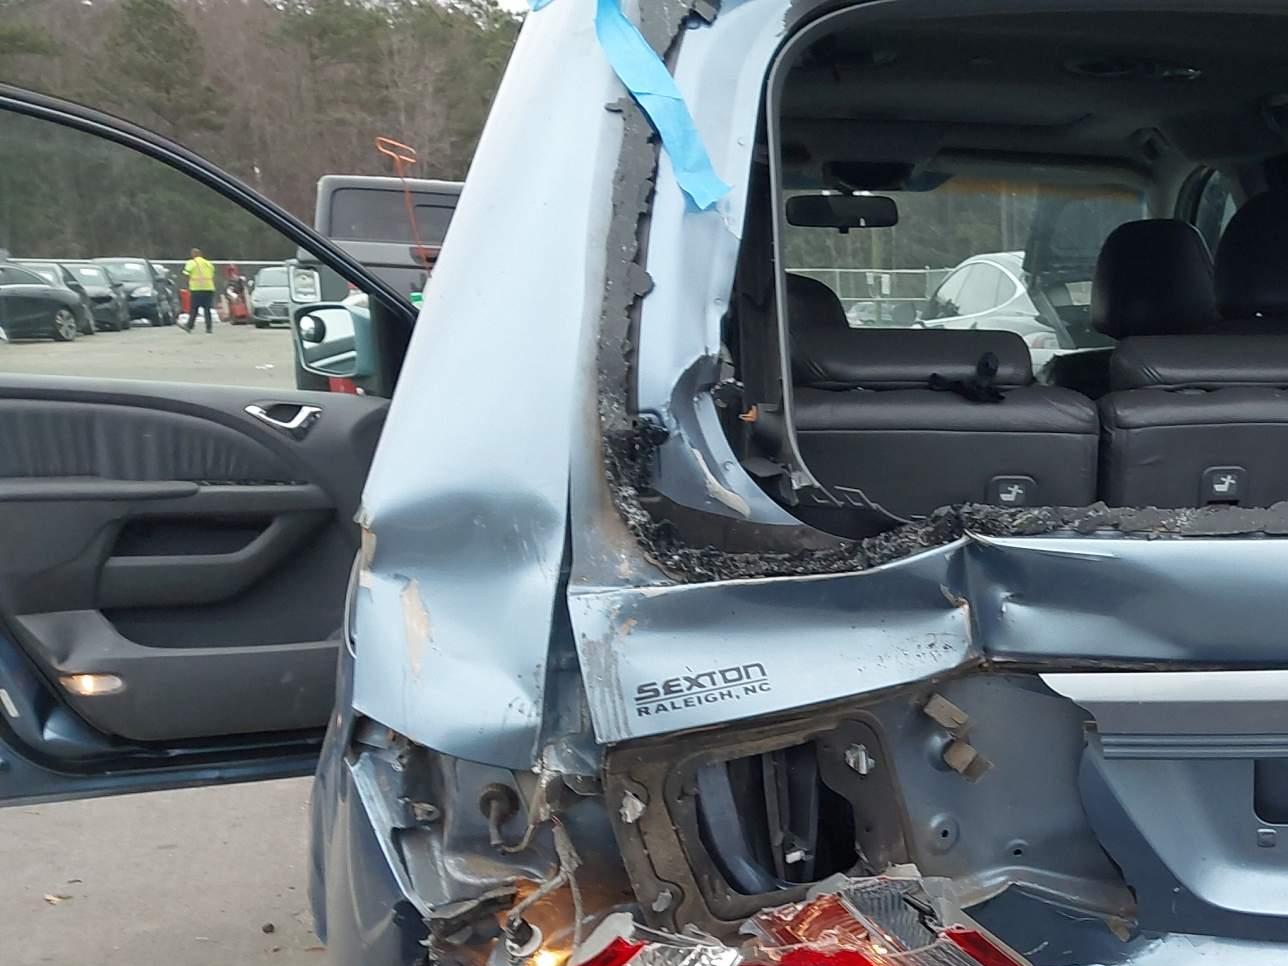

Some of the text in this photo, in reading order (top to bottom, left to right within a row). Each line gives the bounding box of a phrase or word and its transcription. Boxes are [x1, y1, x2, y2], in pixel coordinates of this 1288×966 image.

[634, 662, 767, 702] SEXTON
[636, 682, 772, 717] RALEIGH, NC
